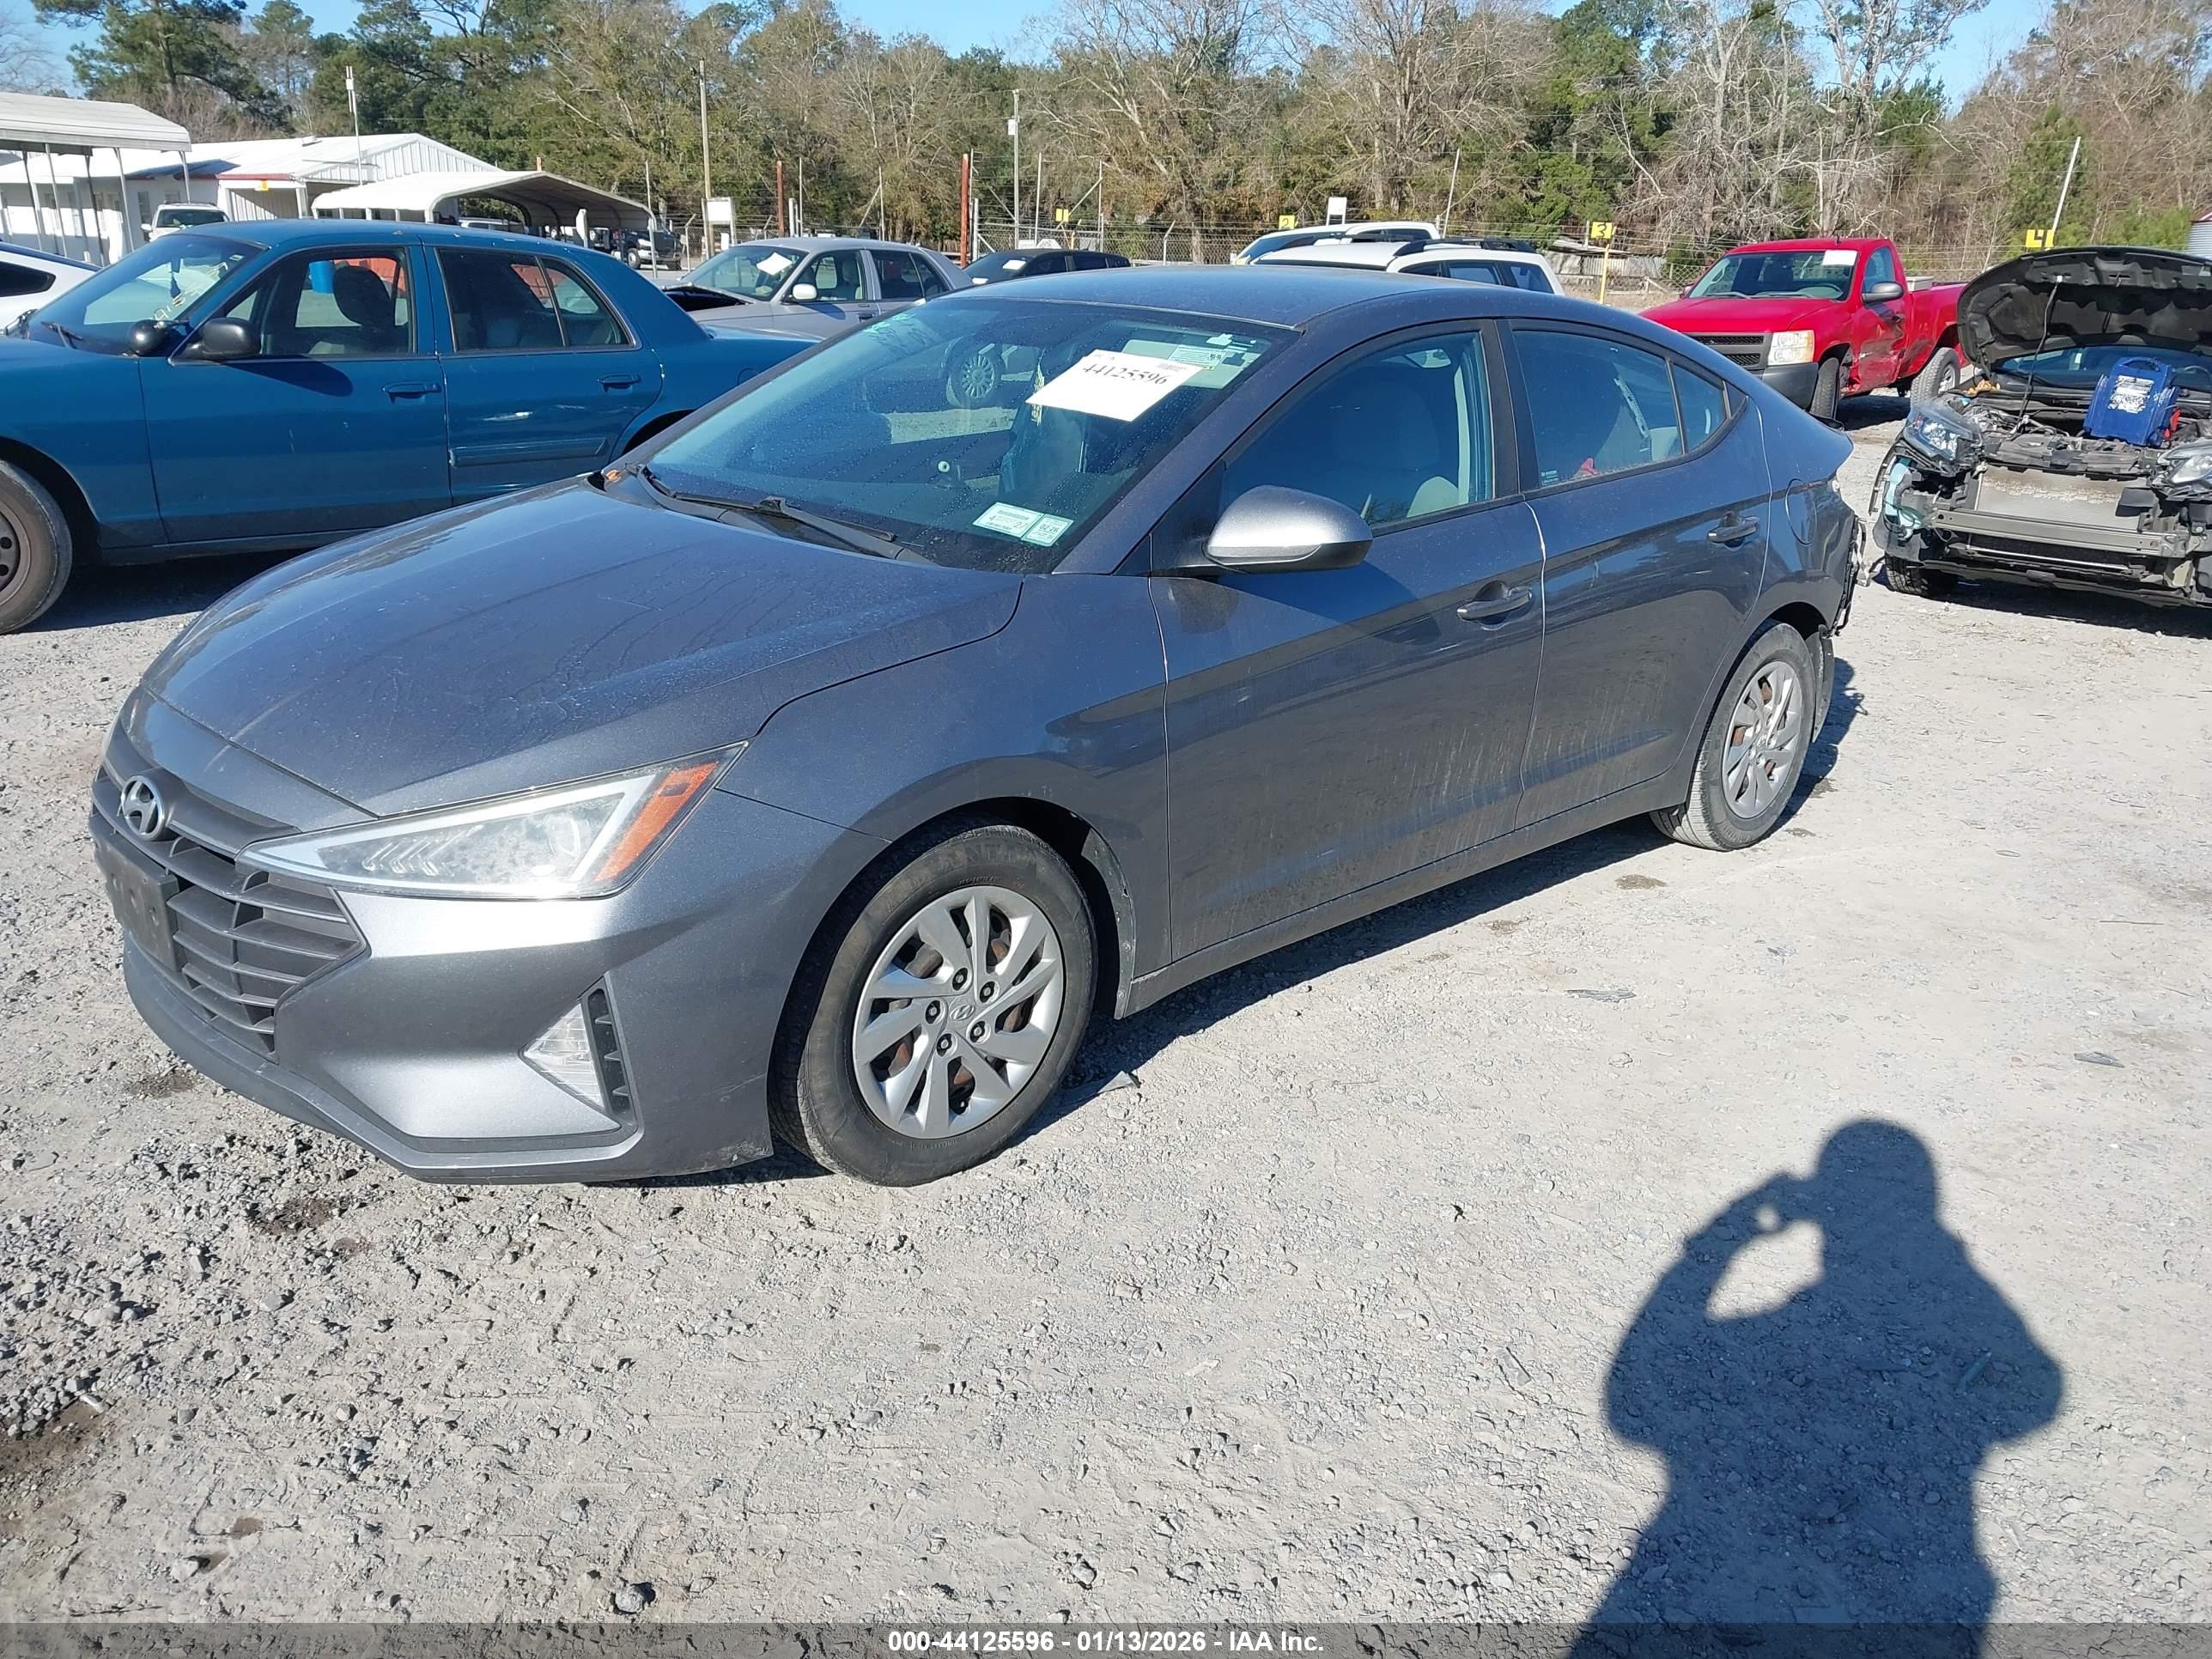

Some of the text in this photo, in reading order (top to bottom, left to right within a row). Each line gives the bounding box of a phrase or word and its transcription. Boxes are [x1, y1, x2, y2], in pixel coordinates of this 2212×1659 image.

[1281, 217, 1291, 229] 2
[1596, 222, 1607, 238] 3
[2033, 228, 2048, 248] 4
[1083, 363, 1169, 385] 44125596
